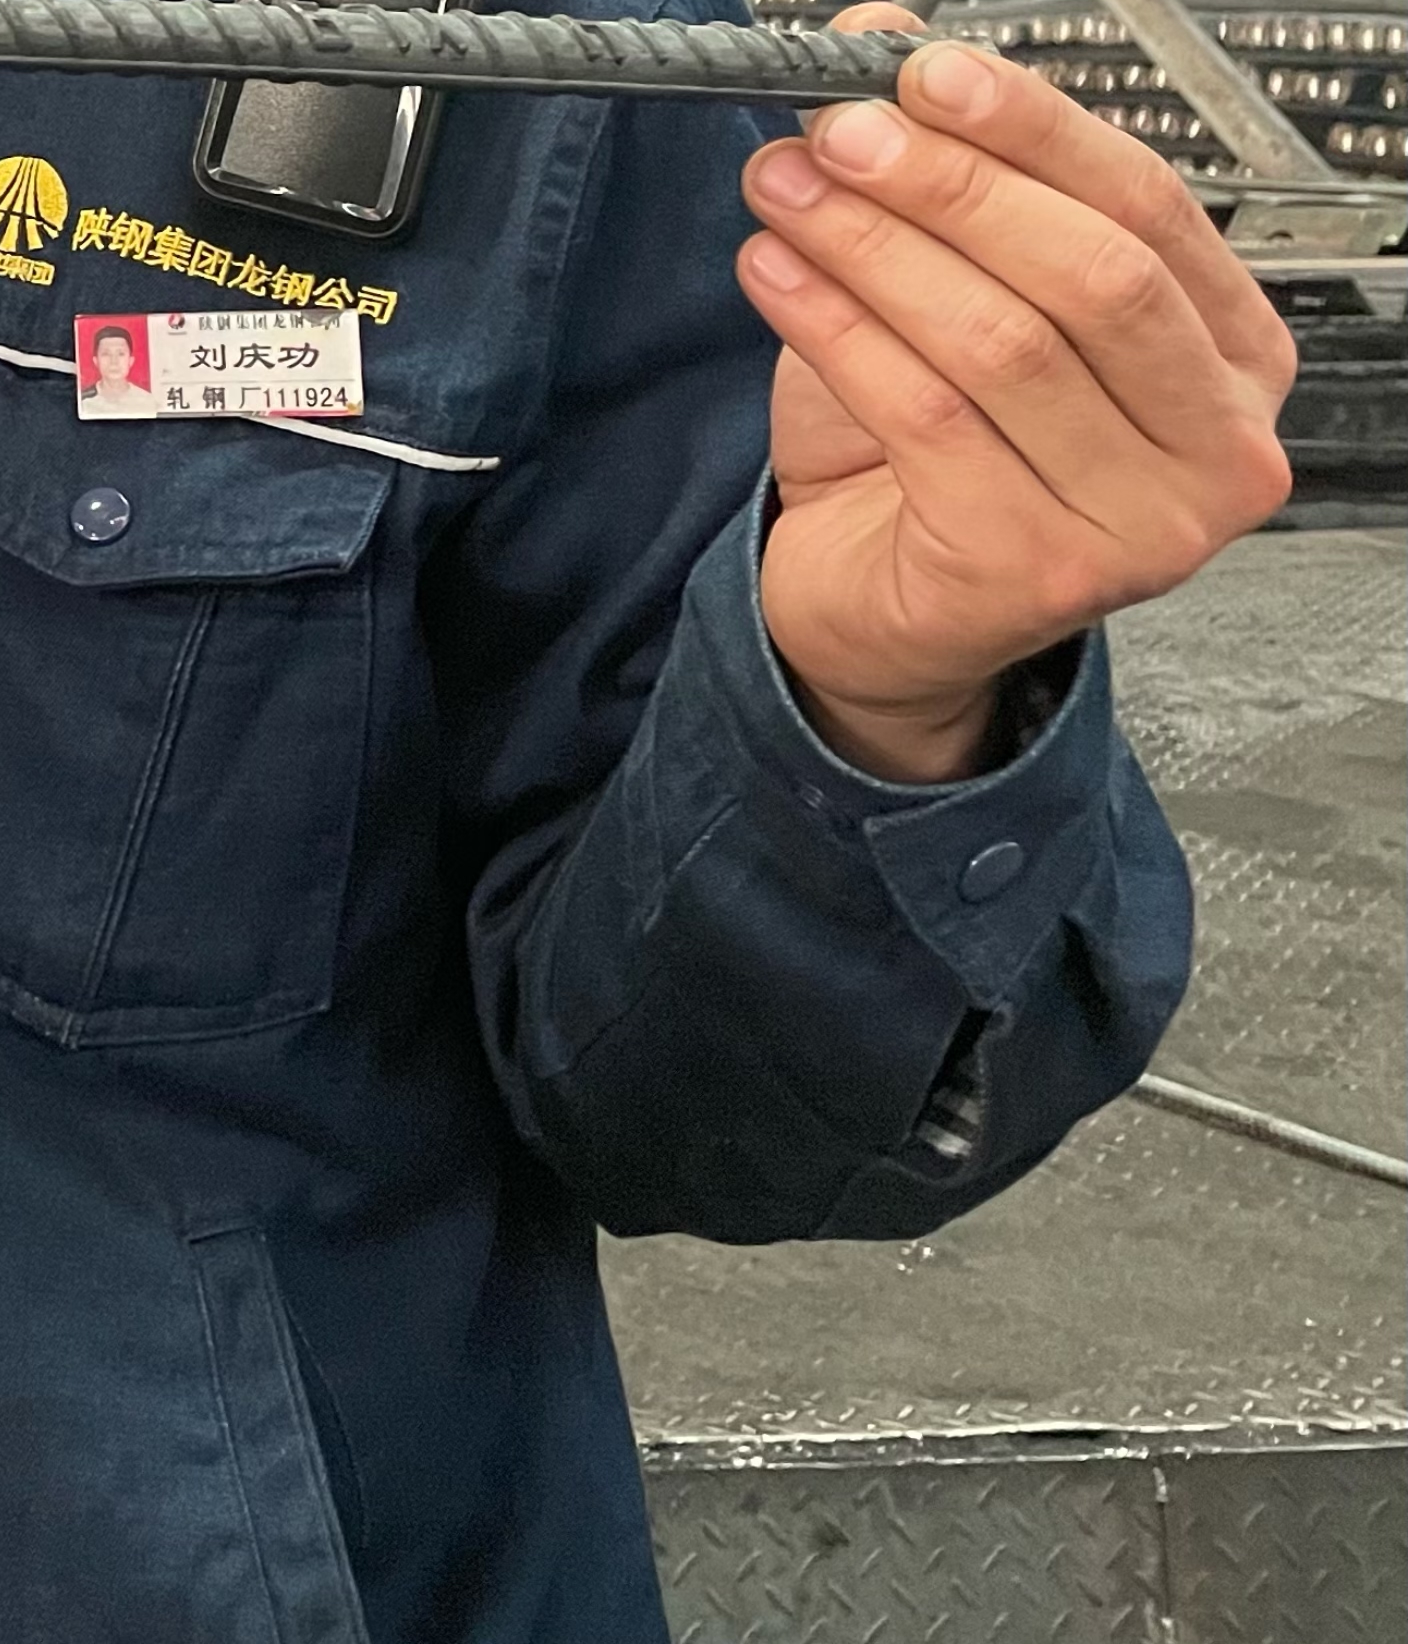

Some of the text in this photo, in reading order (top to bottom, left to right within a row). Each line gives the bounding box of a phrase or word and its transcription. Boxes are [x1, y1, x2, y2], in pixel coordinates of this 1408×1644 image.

[70, 207, 398, 325] 陕钢集团龙钢公司
[189, 342, 320, 371] 刘庆功
